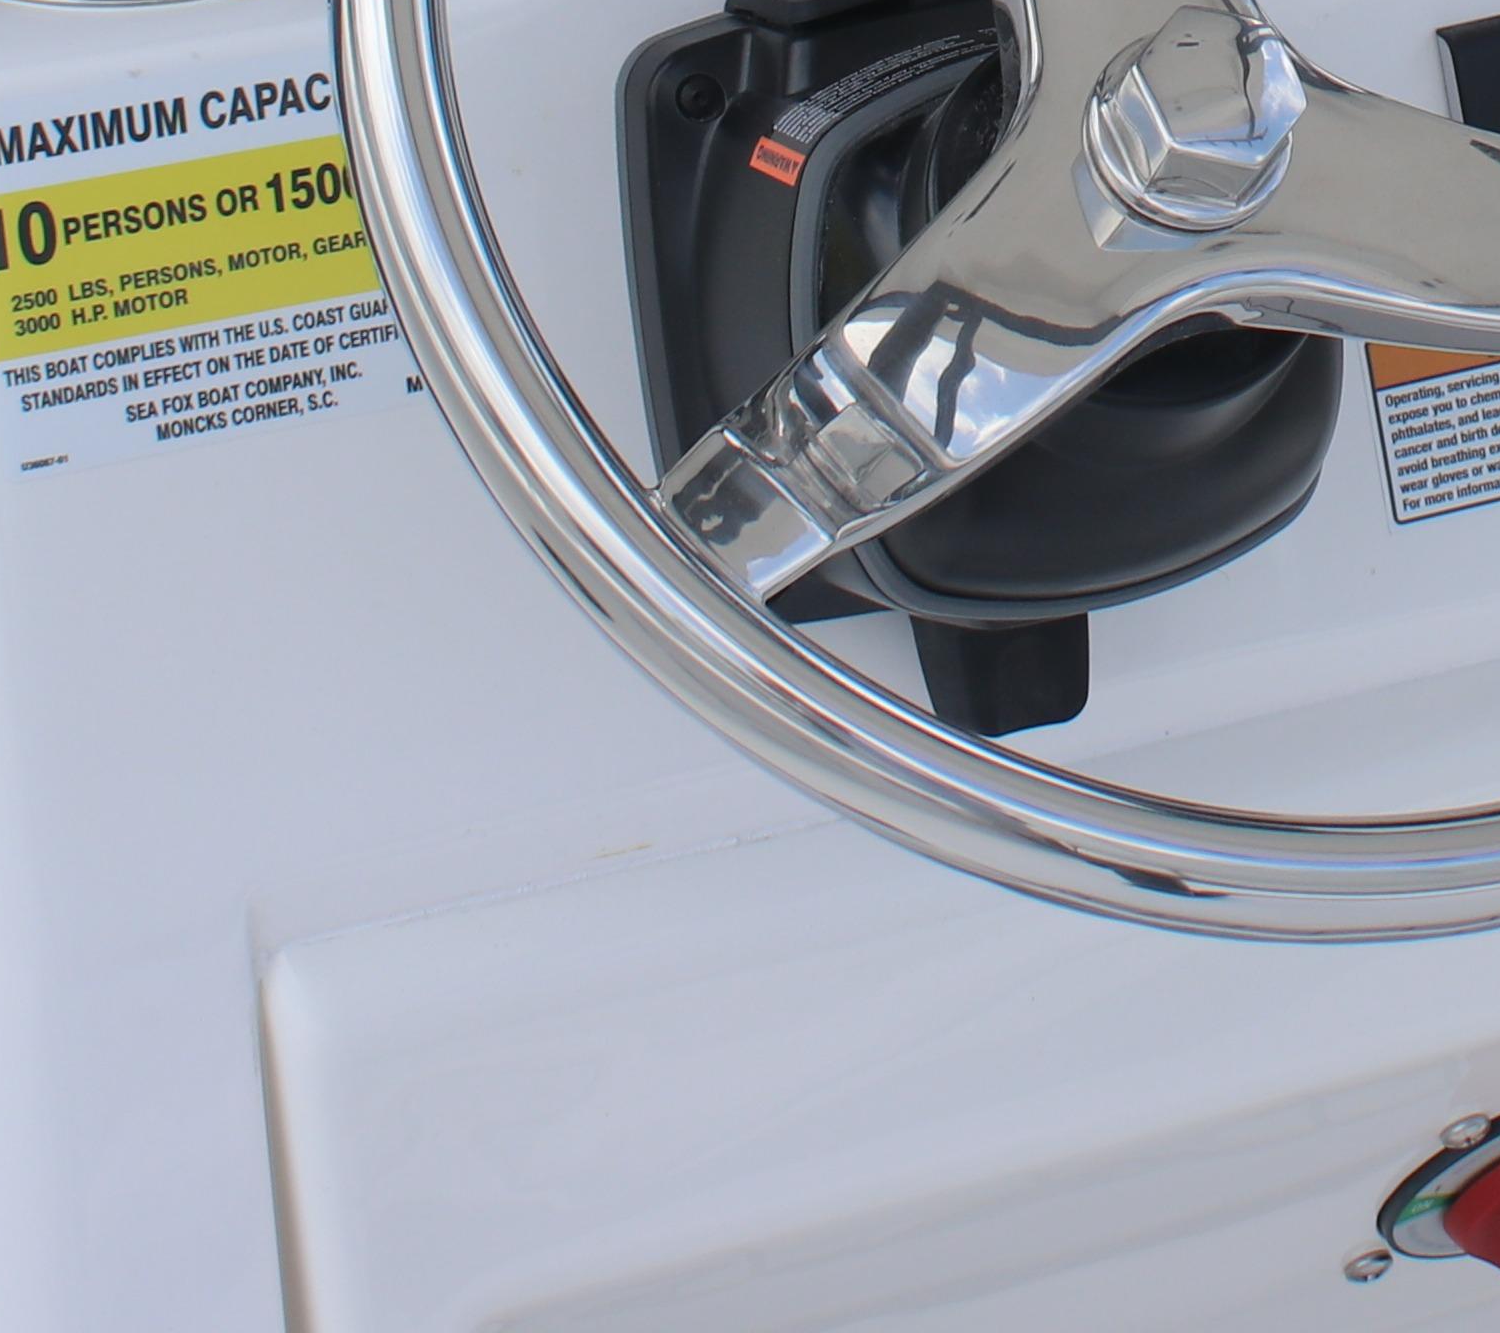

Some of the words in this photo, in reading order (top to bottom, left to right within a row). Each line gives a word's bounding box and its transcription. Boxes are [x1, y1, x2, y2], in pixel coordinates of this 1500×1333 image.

[62, 193, 208, 246] PERSONS
[215, 184, 260, 217] OR
[10, 288, 58, 313] 2500
[68, 278, 114, 302] LBS,
[118, 258, 223, 293] PERSONS,
[227, 242, 308, 272] MOTOR,
[14, 312, 61, 337] 3000
[70, 303, 109, 326] H.P.
[112, 288, 189, 318] MOTOR
[2, 364, 42, 388] THIS
[44, 355, 89, 381] BOAT
[92, 338, 177, 371] COMPLIES
[178, 329, 221, 354] WITH
[222, 323, 256, 345] THE
[258, 317, 290, 339] U.S.
[292, 305, 345, 332] COAST
[20, 376, 119, 413] STANDARDS
[121, 372, 140, 393] IN
[142, 360, 203, 389] EFFECT
[206, 355, 231, 376] ON
[232, 348, 266, 371] THE
[268, 339, 311, 364] DATE
[312, 334, 335, 356] OF
[125, 400, 159, 423] SEA
[161, 392, 195, 416] FOX
[196, 383, 241, 409] BOAT
[244, 367, 327, 399] COMPANY,
[329, 361, 363, 383] INC.
[1384, 386, 1446, 409] Operating,
[1446, 372, 1500, 394] servicing
[155, 411, 228, 442] MONCKS
[231, 397, 304, 427] CORNER,
[307, 390, 339, 412] S.C.
[1388, 406, 1430, 425] expose
[1431, 400, 1454, 418] you
[1455, 397, 1468, 410] to
[1391, 419, 1456, 445] phthalates,
[1457, 409, 1480, 427] and
[1394, 441, 1433, 460] cancer
[1436, 432, 1459, 450] and
[1460, 426, 1489, 444] birth
[1397, 457, 1429, 477] avoid
[1430, 446, 1487, 469] breathing
[1399, 477, 1429, 495] wear
[1431, 468, 1470, 489] gloves
[1471, 465, 1484, 477] or
[1402, 497, 1421, 512] For
[1424, 490, 1454, 507] more
